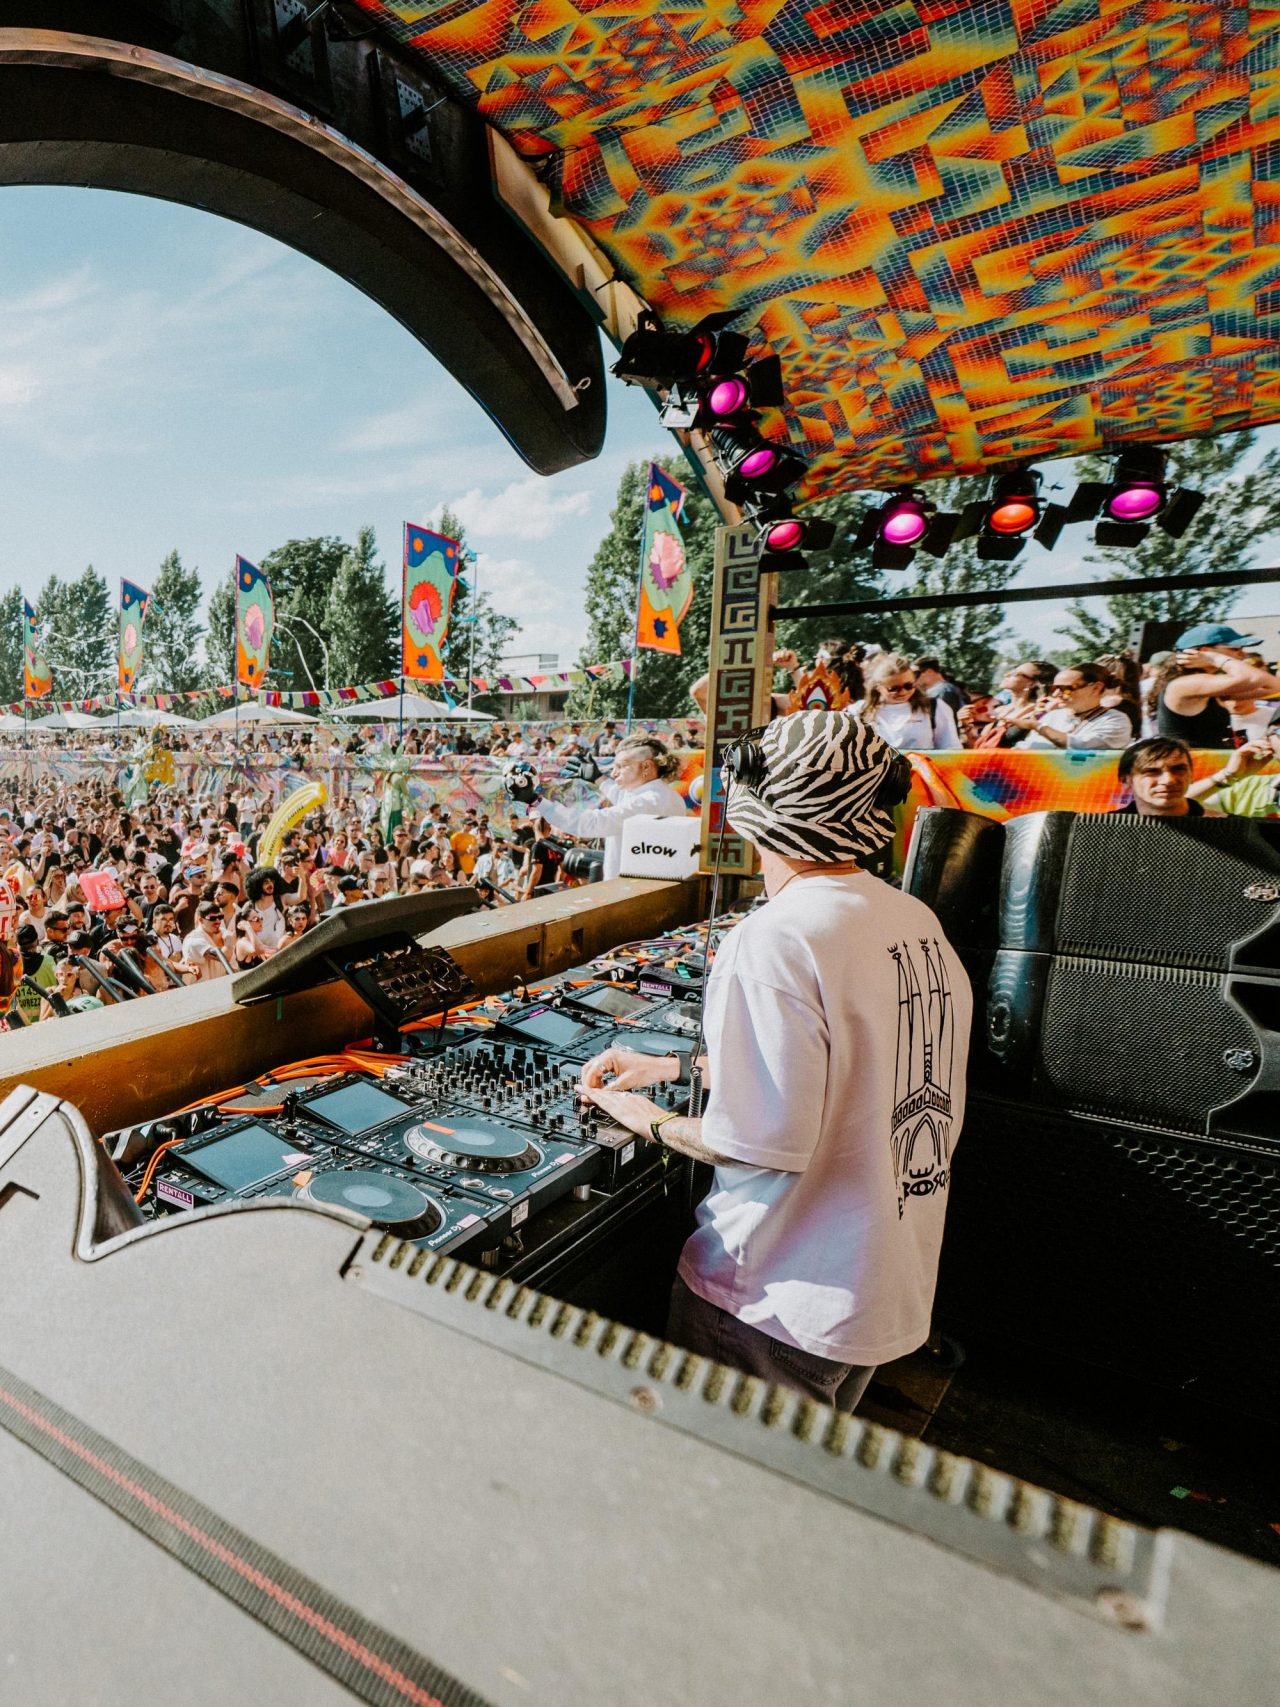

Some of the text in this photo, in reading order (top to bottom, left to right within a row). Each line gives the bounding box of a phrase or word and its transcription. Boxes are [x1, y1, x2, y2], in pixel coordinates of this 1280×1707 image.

[631, 842, 677, 857] elrow
[642, 982, 670, 991] RENTALL
[160, 1183, 191, 1203] RENTALL
[428, 1229, 453, 1247] Pioneer
